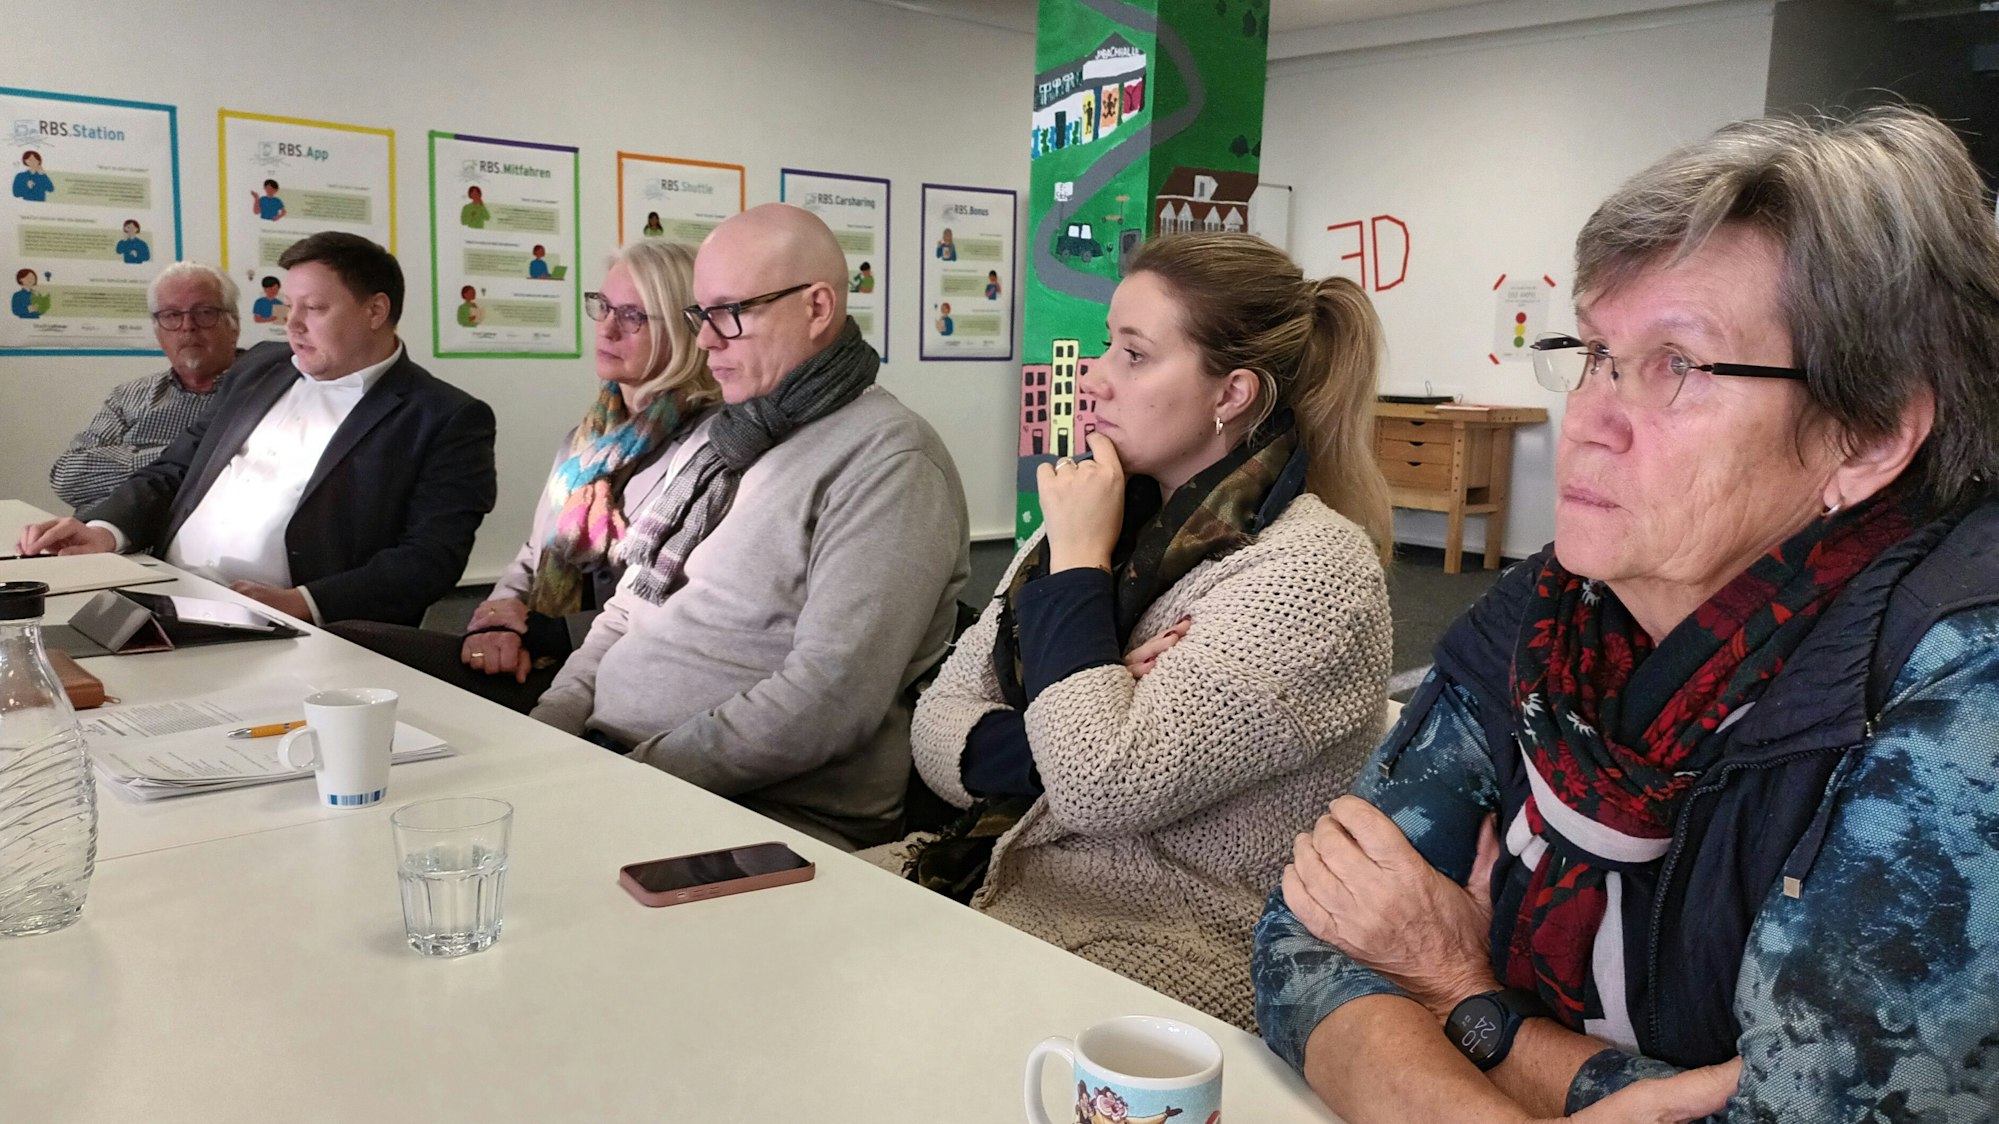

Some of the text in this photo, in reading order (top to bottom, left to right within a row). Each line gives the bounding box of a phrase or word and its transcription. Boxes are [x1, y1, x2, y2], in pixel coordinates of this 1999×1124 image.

[39, 120, 126, 141] RBS.Station
[278, 142, 329, 162] RBS.App
[480, 160, 551, 178] RBS.Mitfahren
[818, 193, 876, 210] RBS.Carsharing
[954, 204, 989, 216] RBS.Bonus
